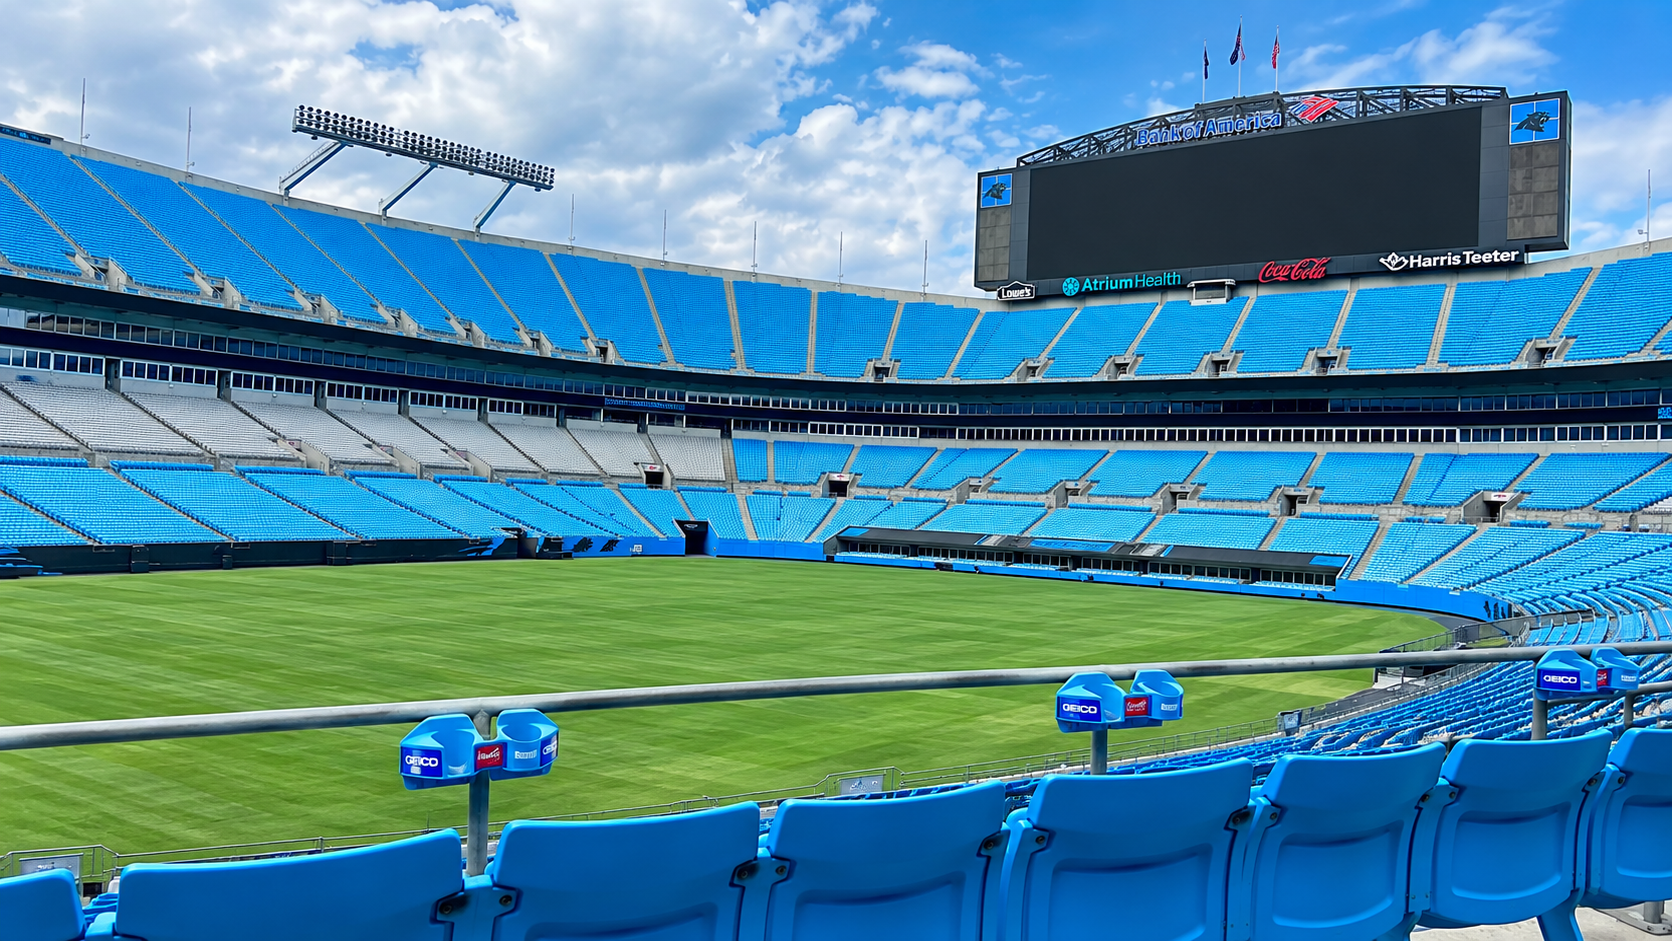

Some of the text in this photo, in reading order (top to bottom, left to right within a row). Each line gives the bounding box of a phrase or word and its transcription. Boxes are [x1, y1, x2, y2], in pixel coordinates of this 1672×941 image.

[1136, 111, 1282, 146] Bank of America
[1409, 249, 1519, 269] Harris Teeter
[1543, 674, 1577, 684] GEICO
[1062, 703, 1097, 714] GEICO
[405, 755, 439, 767] GEICO
